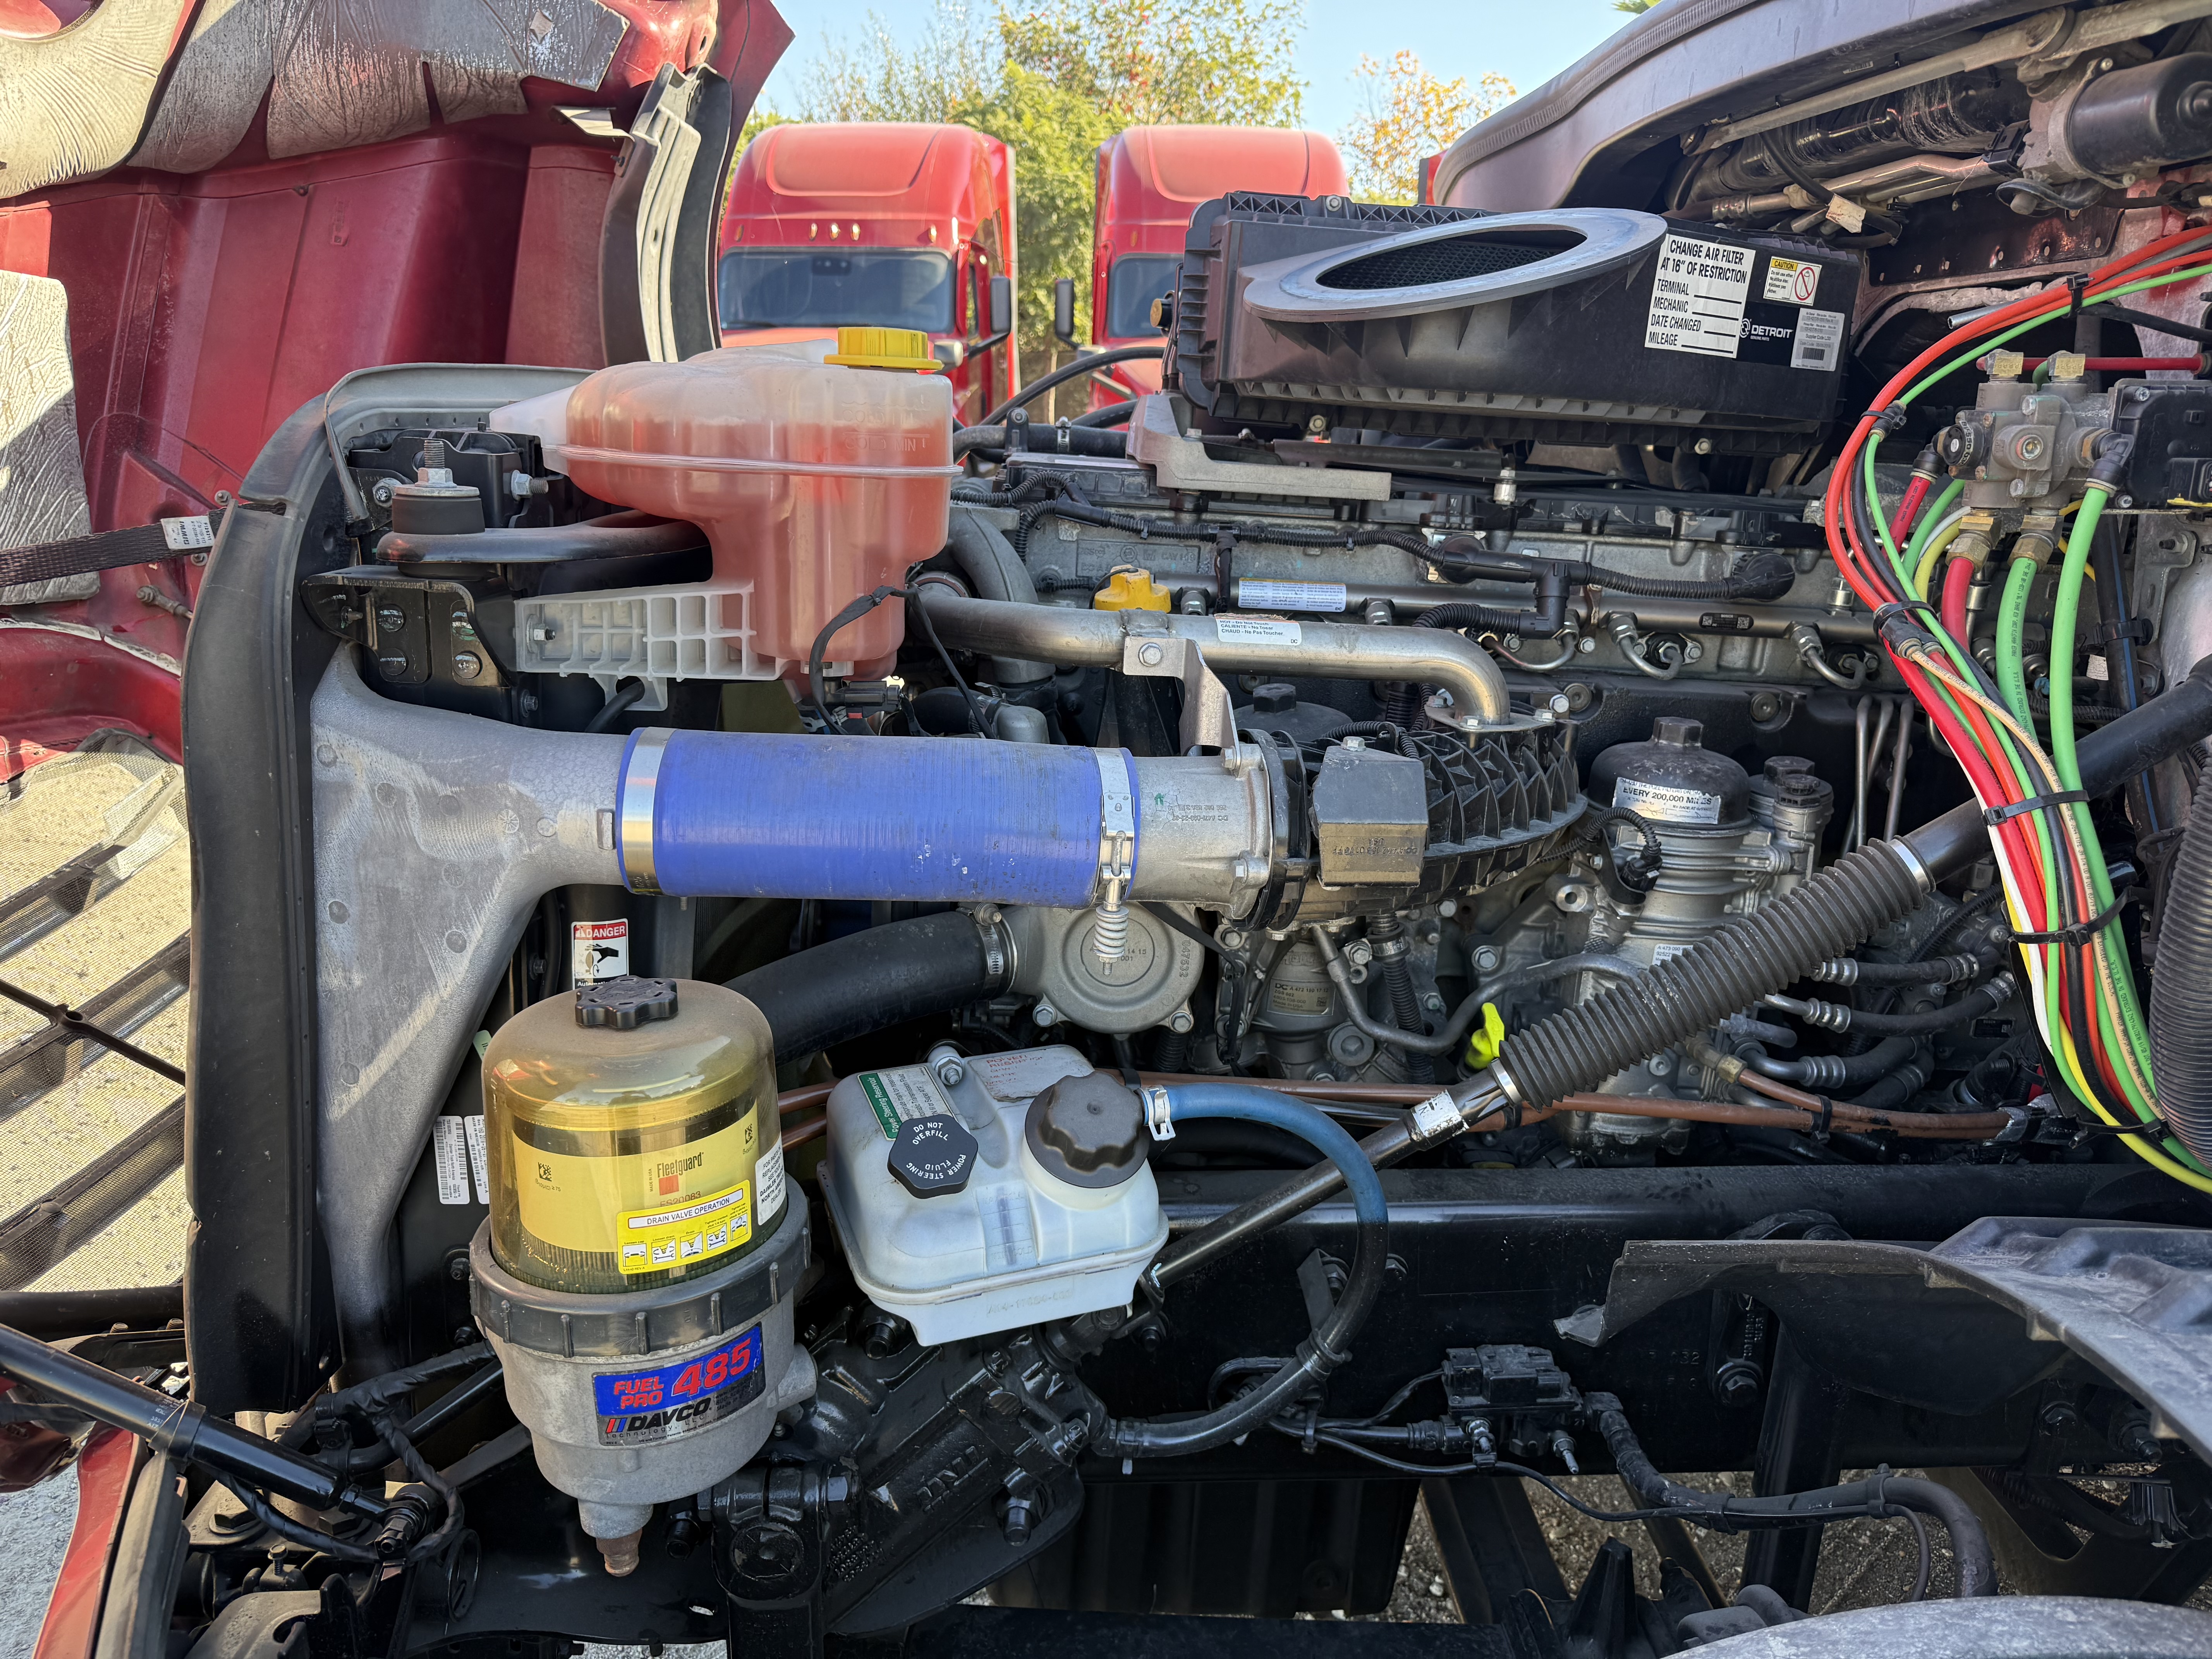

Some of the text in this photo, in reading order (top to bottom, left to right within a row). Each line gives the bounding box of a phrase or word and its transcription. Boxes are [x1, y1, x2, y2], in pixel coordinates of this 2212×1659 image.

[1670, 240, 1744, 265] CHANGE AIR FILTER
[1661, 257, 1670, 271] AT
[1687, 261, 1697, 275] OF
[1698, 263, 1747, 284] RESTRICTION
[1774, 261, 1794, 270] CAUTION
[1657, 279, 1689, 295] TERMINAL
[1654, 296, 1688, 313] MECHANIC
[1651, 314, 1701, 331] DATE CHANGED
[1751, 325, 1794, 338] DETROIT
[1649, 331, 1678, 346] MILEAGE
[1947, 673, 1968, 689] EXTRUDED
[1975, 690, 1984, 699] THE
[2011, 720, 2026, 735] PARKER
[2025, 733, 2043, 755] HANNIFIN
[2053, 778, 2064, 792] BRAKE
[1623, 787, 1650, 797] EVERY
[1652, 792, 1684, 803] 200,000
[586, 926, 625, 938] DANGER
[1179, 940, 1191, 977] 047532
[2120, 992, 2130, 1014] EXTRUDED
[903, 1082, 919, 1104] Transmission
[867, 1077, 898, 1132] Power Steering Reservoir
[912, 1130, 948, 1145] OVERFILL
[913, 1124, 924, 1133] DO
[657, 1152, 703, 1178] Fleetguard
[770, 1151, 778, 1162] PARTS
[925, 1160, 951, 1171] FLUID
[906, 1154, 966, 1179] POWER STEERING
[760, 1178, 776, 1197] DAIMLER
[761, 1188, 775, 1204] NORTH
[771, 1187, 781, 1203] DEALER
[647, 1197, 730, 1225] DRAIN VALVE OPERATION
[671, 1337, 752, 1397] 485
[613, 1376, 664, 1396] FUEL
[620, 1391, 663, 1409] PRO
[627, 1397, 711, 1432] DAVCO
